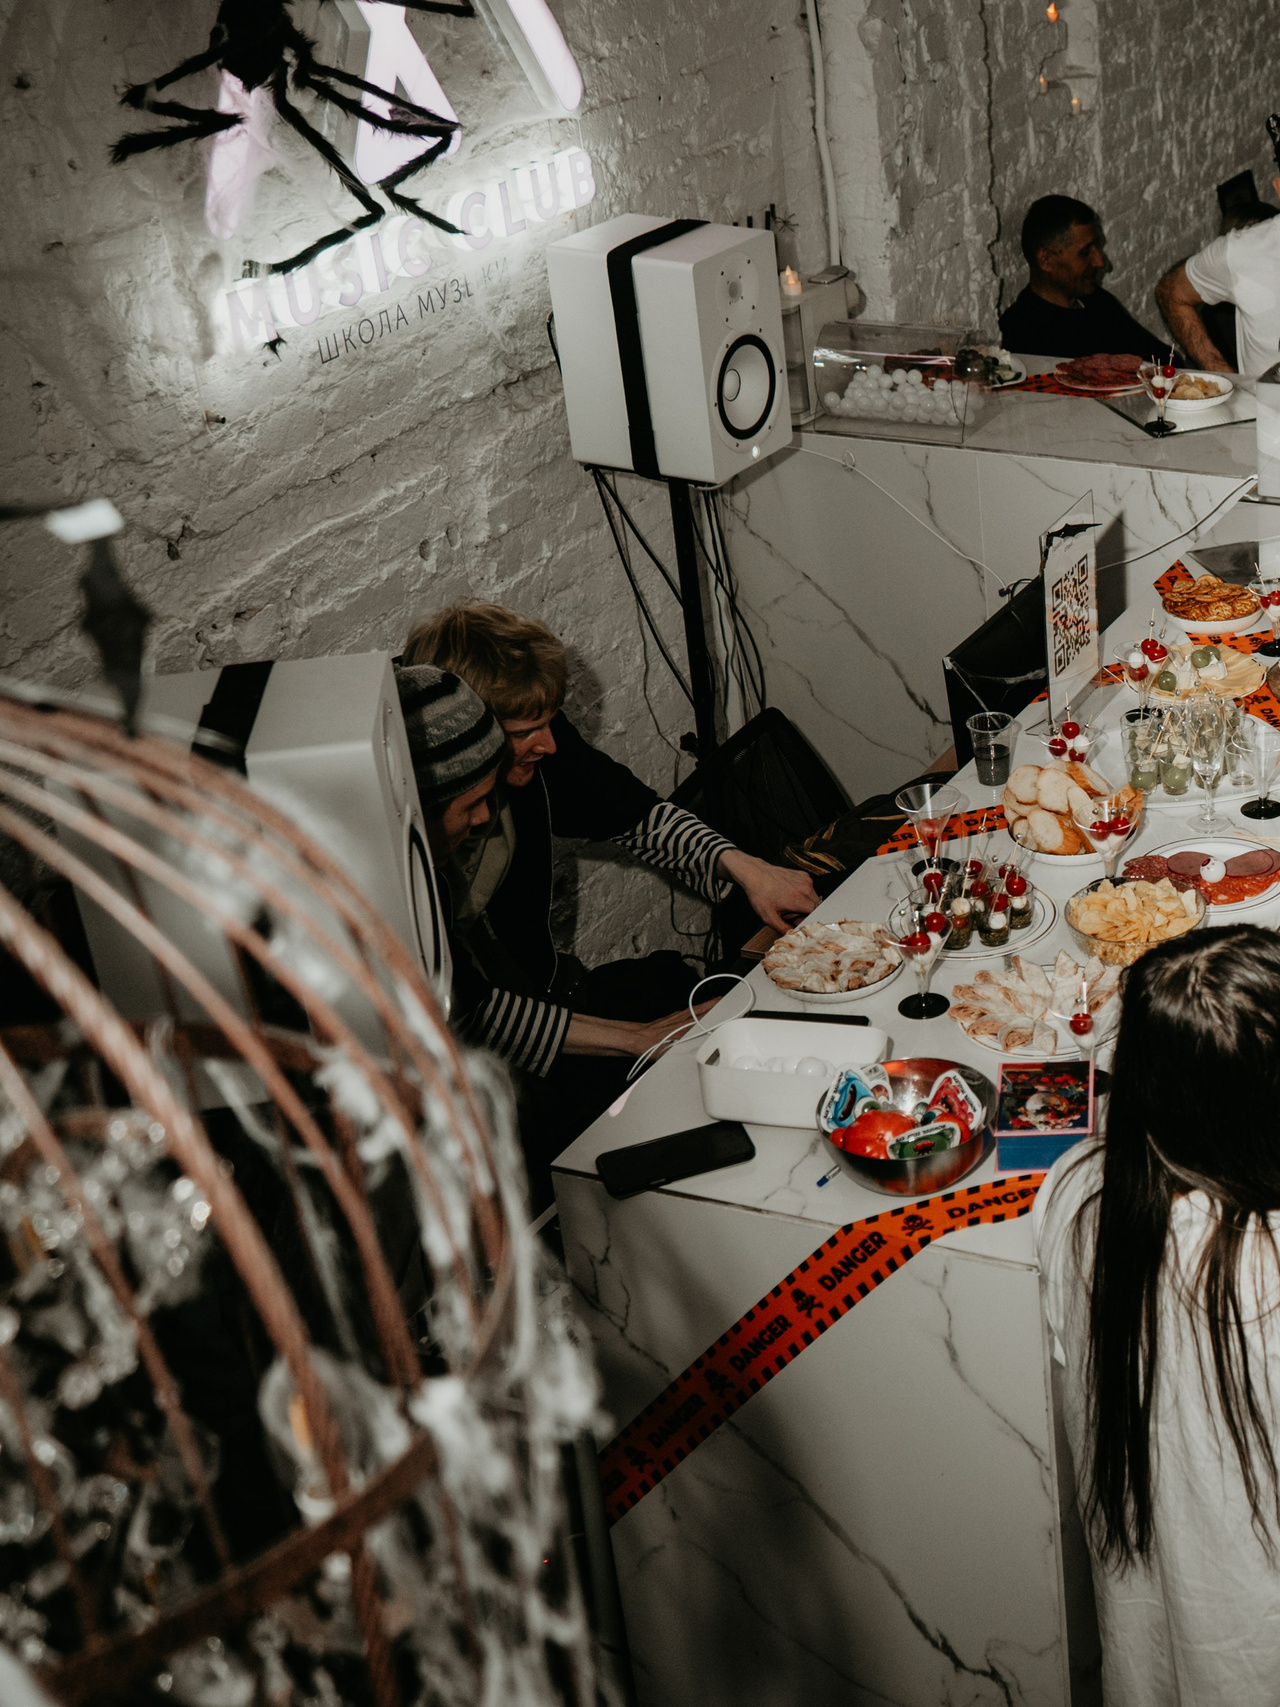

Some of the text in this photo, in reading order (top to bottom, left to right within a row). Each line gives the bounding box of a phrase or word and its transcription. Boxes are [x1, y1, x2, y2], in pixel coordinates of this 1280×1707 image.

[226, 149, 596, 352] MUSIC CLUB
[317, 304, 409, 364] ШКОЛА
[648, 1393, 707, 1449] DANGER
[728, 1314, 793, 1373] DANGER
[817, 1230, 887, 1292] DANGER
